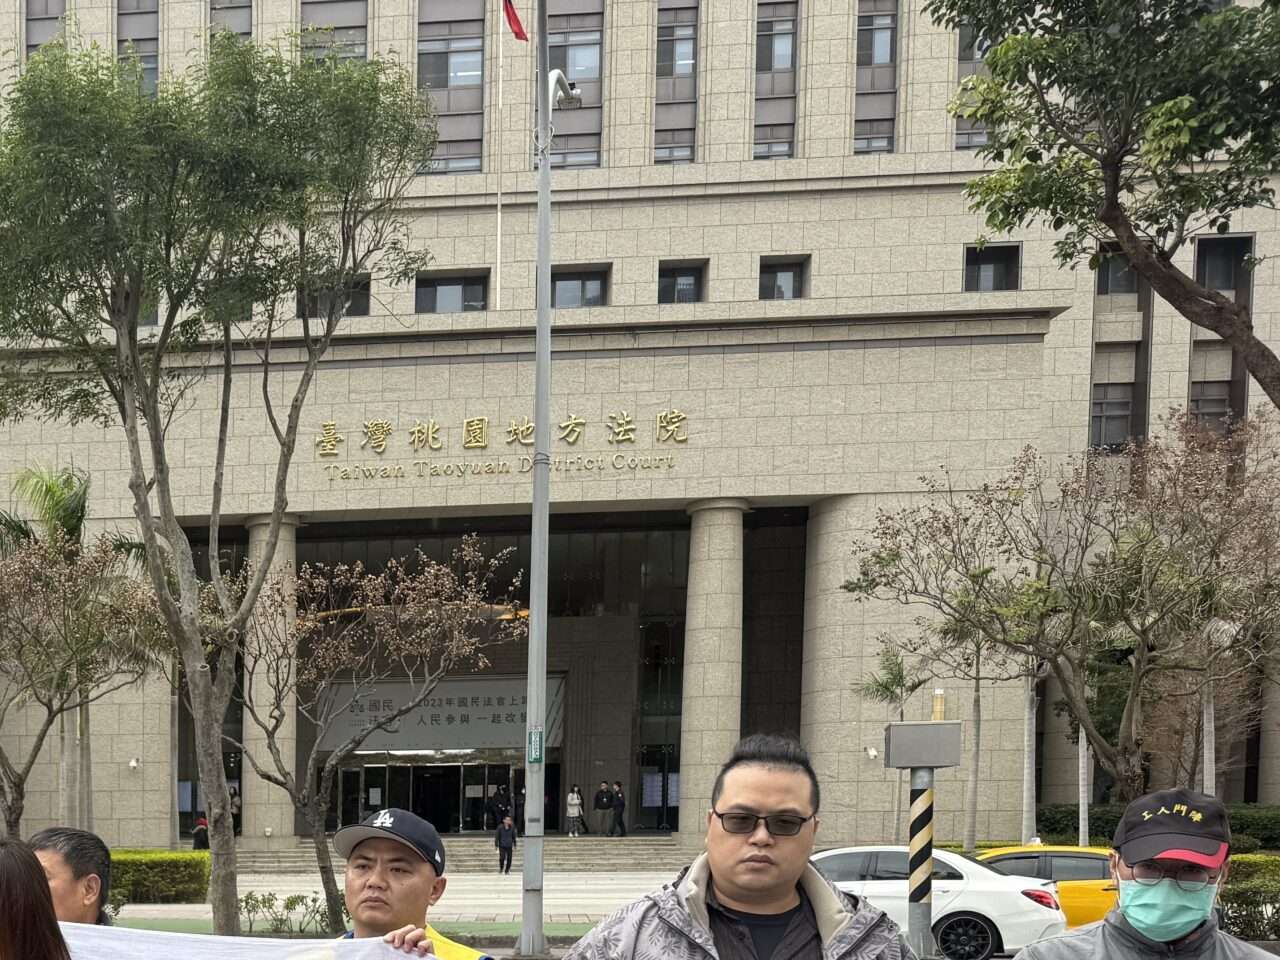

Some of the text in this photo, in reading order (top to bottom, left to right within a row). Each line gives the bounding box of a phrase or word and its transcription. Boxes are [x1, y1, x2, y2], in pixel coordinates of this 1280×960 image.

[315, 409, 689, 457] 臺灣桃園地方法院
[324, 453, 675, 481] Taiwan Taoyuan Dtrict Court
[372, 804, 394, 828] LA
